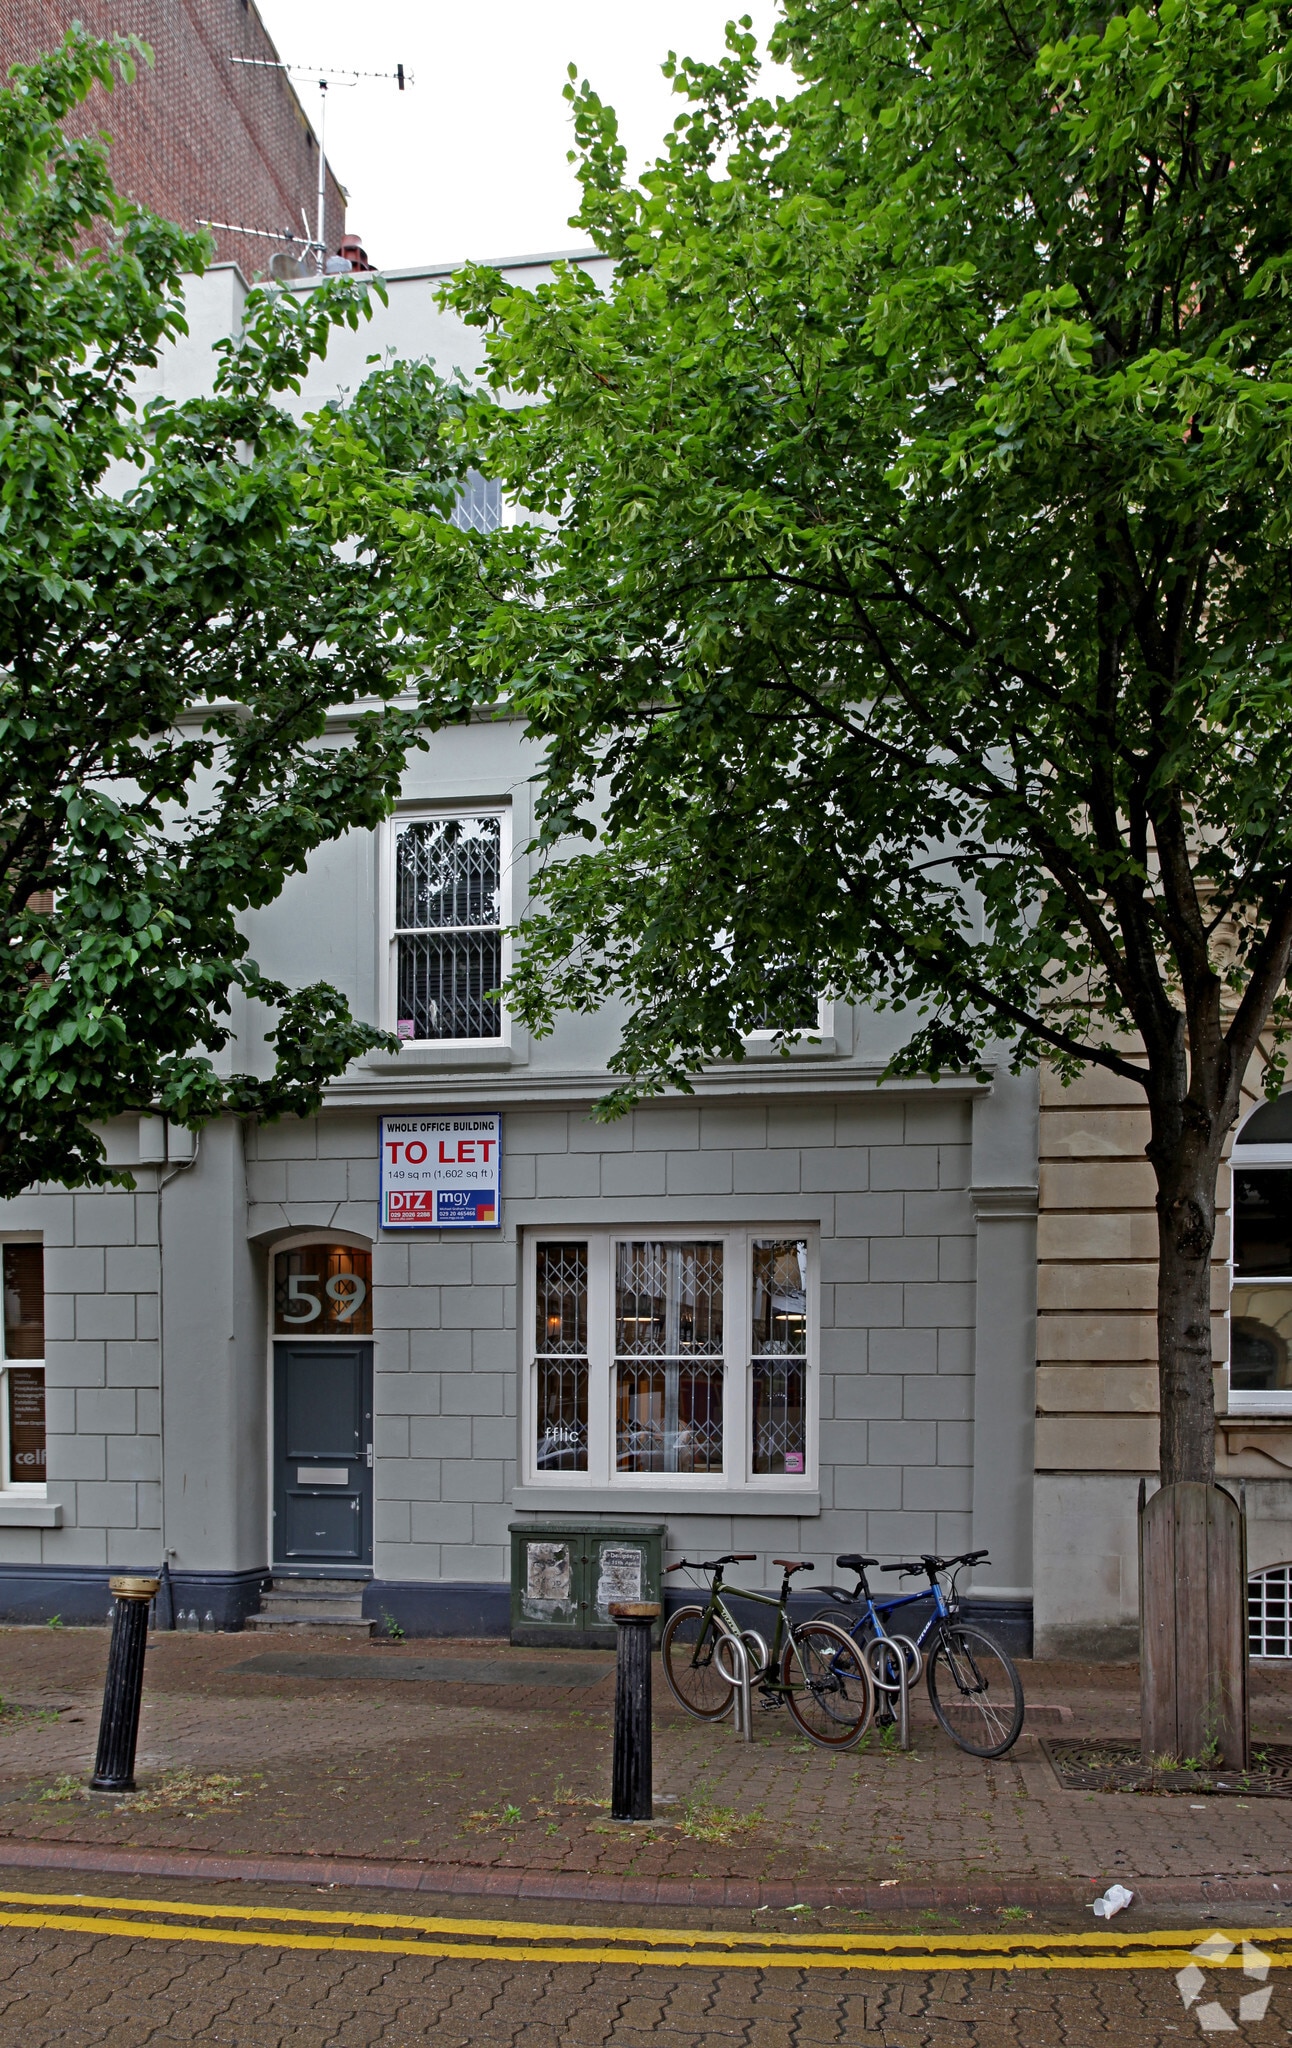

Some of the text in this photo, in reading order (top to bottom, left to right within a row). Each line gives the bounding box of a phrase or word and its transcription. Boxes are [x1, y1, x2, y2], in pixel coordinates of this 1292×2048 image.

[387, 1121, 494, 1132] WHOLE OFFICE BUILDING
[386, 1140, 496, 1164] TO LET
[389, 1170, 405, 1179] 149
[408, 1172, 419, 1180] sq
[434, 1170, 463, 1179] (1,602
[466, 1171, 478, 1179] sq
[480, 1169, 488, 1178] ft
[390, 1192, 426, 1210] DTZ
[439, 1192, 470, 1206] mgy
[284, 1273, 366, 1324] 59
[545, 1427, 579, 1442] fflic
